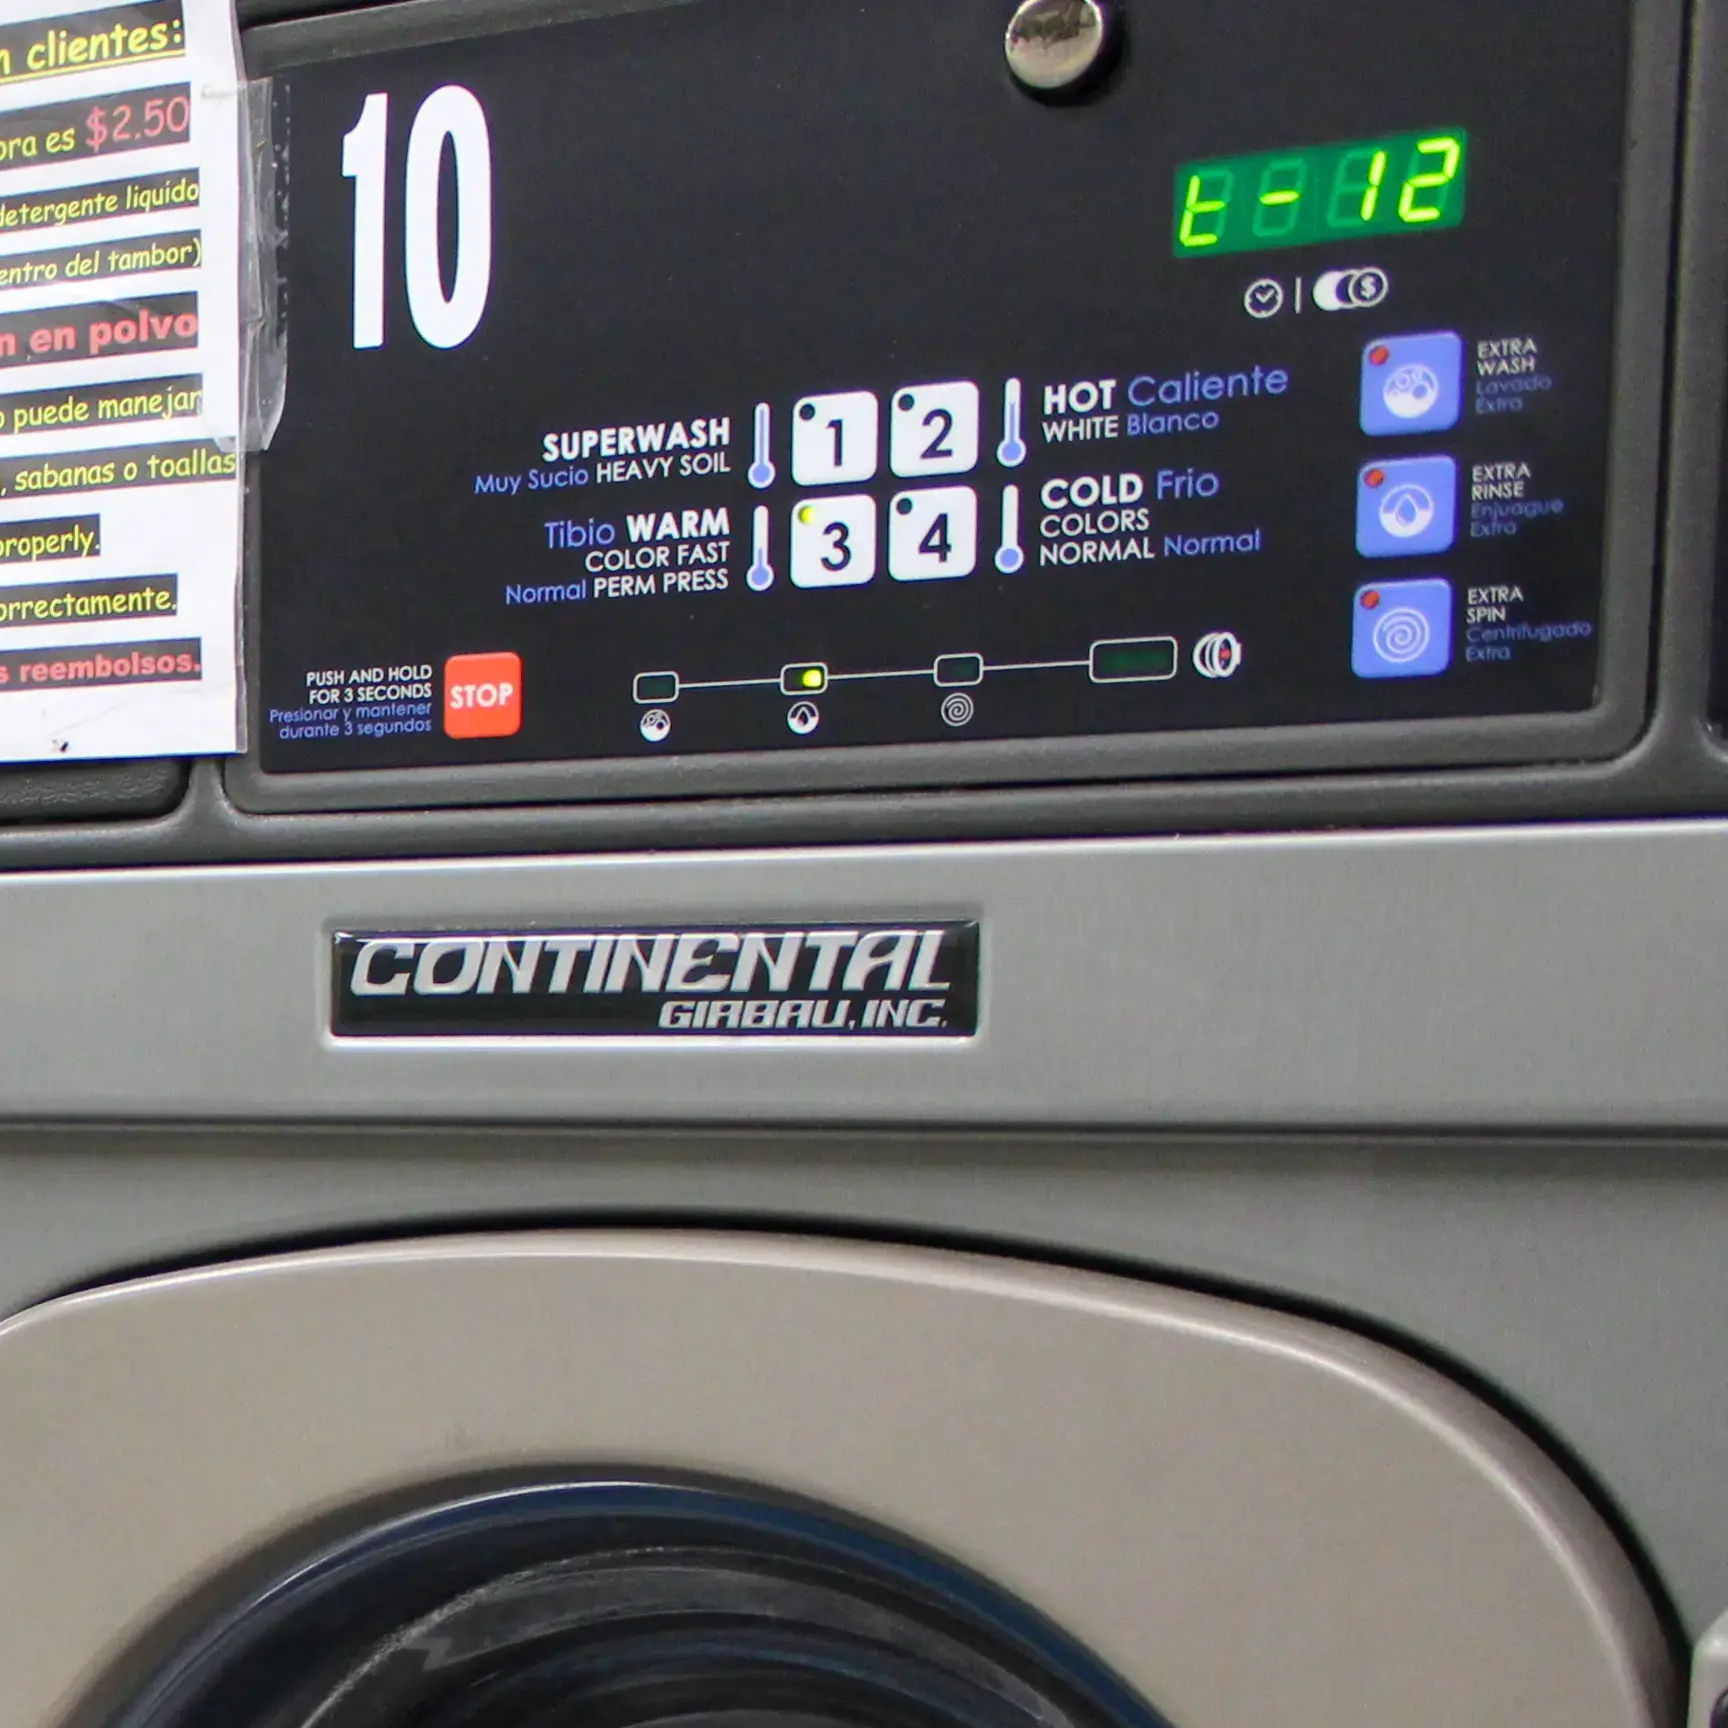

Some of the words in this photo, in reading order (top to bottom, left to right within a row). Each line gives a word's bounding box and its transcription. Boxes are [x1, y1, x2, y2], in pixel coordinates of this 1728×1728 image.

[27, 20, 183, 72] clientes:
[46, 127, 76, 154] es
[86, 96, 189, 153] $2.50
[341, 83, 493, 350] 10
[30, 324, 76, 352] en
[90, 309, 198, 356] polvo
[1476, 338, 1537, 359] EXTRA
[1476, 355, 1535, 377] WASH
[1043, 379, 1117, 416] HOT
[1127, 364, 1289, 407] Caliente
[13, 397, 88, 434] puede
[97, 387, 202, 422] manejar
[1043, 414, 1119, 444] WHITE
[1126, 408, 1220, 438] Blanco
[543, 416, 731, 463] SUPERWASH
[826, 417, 845, 468] 1
[921, 407, 954, 460] 2
[14, 459, 114, 492] sabanas
[123, 461, 138, 482] o
[146, 450, 236, 480] toallas
[475, 473, 521, 496] Muy
[529, 465, 589, 490] Sucio
[596, 457, 672, 486] HEAVY
[679, 450, 731, 476] SOIL
[1041, 472, 1143, 510] COLD
[1156, 467, 1220, 501] Frio
[1471, 462, 1531, 483] EXTRA
[1471, 480, 1525, 501] RINSE
[544, 517, 615, 550] Tibio
[627, 507, 730, 544] WARM
[1040, 507, 1149, 538] COLORS
[585, 547, 670, 574] COLOR
[678, 540, 730, 566] FAST
[821, 521, 852, 572] 3
[919, 512, 952, 564] 4
[1040, 536, 1155, 567] NORMAL
[1163, 528, 1261, 558] Normal
[506, 577, 586, 605] Normal
[593, 575, 656, 600] PERM
[663, 568, 729, 593] PRESS
[1467, 585, 1524, 605] EXTRA
[1467, 603, 1507, 624] SPIN
[20, 651, 201, 684] reembolsos.
[306, 668, 345, 688] PUSH
[349, 666, 383, 685] AND
[388, 663, 432, 682] HOLD
[309, 686, 340, 705] FOR
[344, 685, 353, 702] 3
[357, 681, 432, 701] SECONDS
[450, 681, 514, 709] STOP
[350, 929, 951, 997] CONTINENTAL
[861, 999, 948, 1028] INC.
